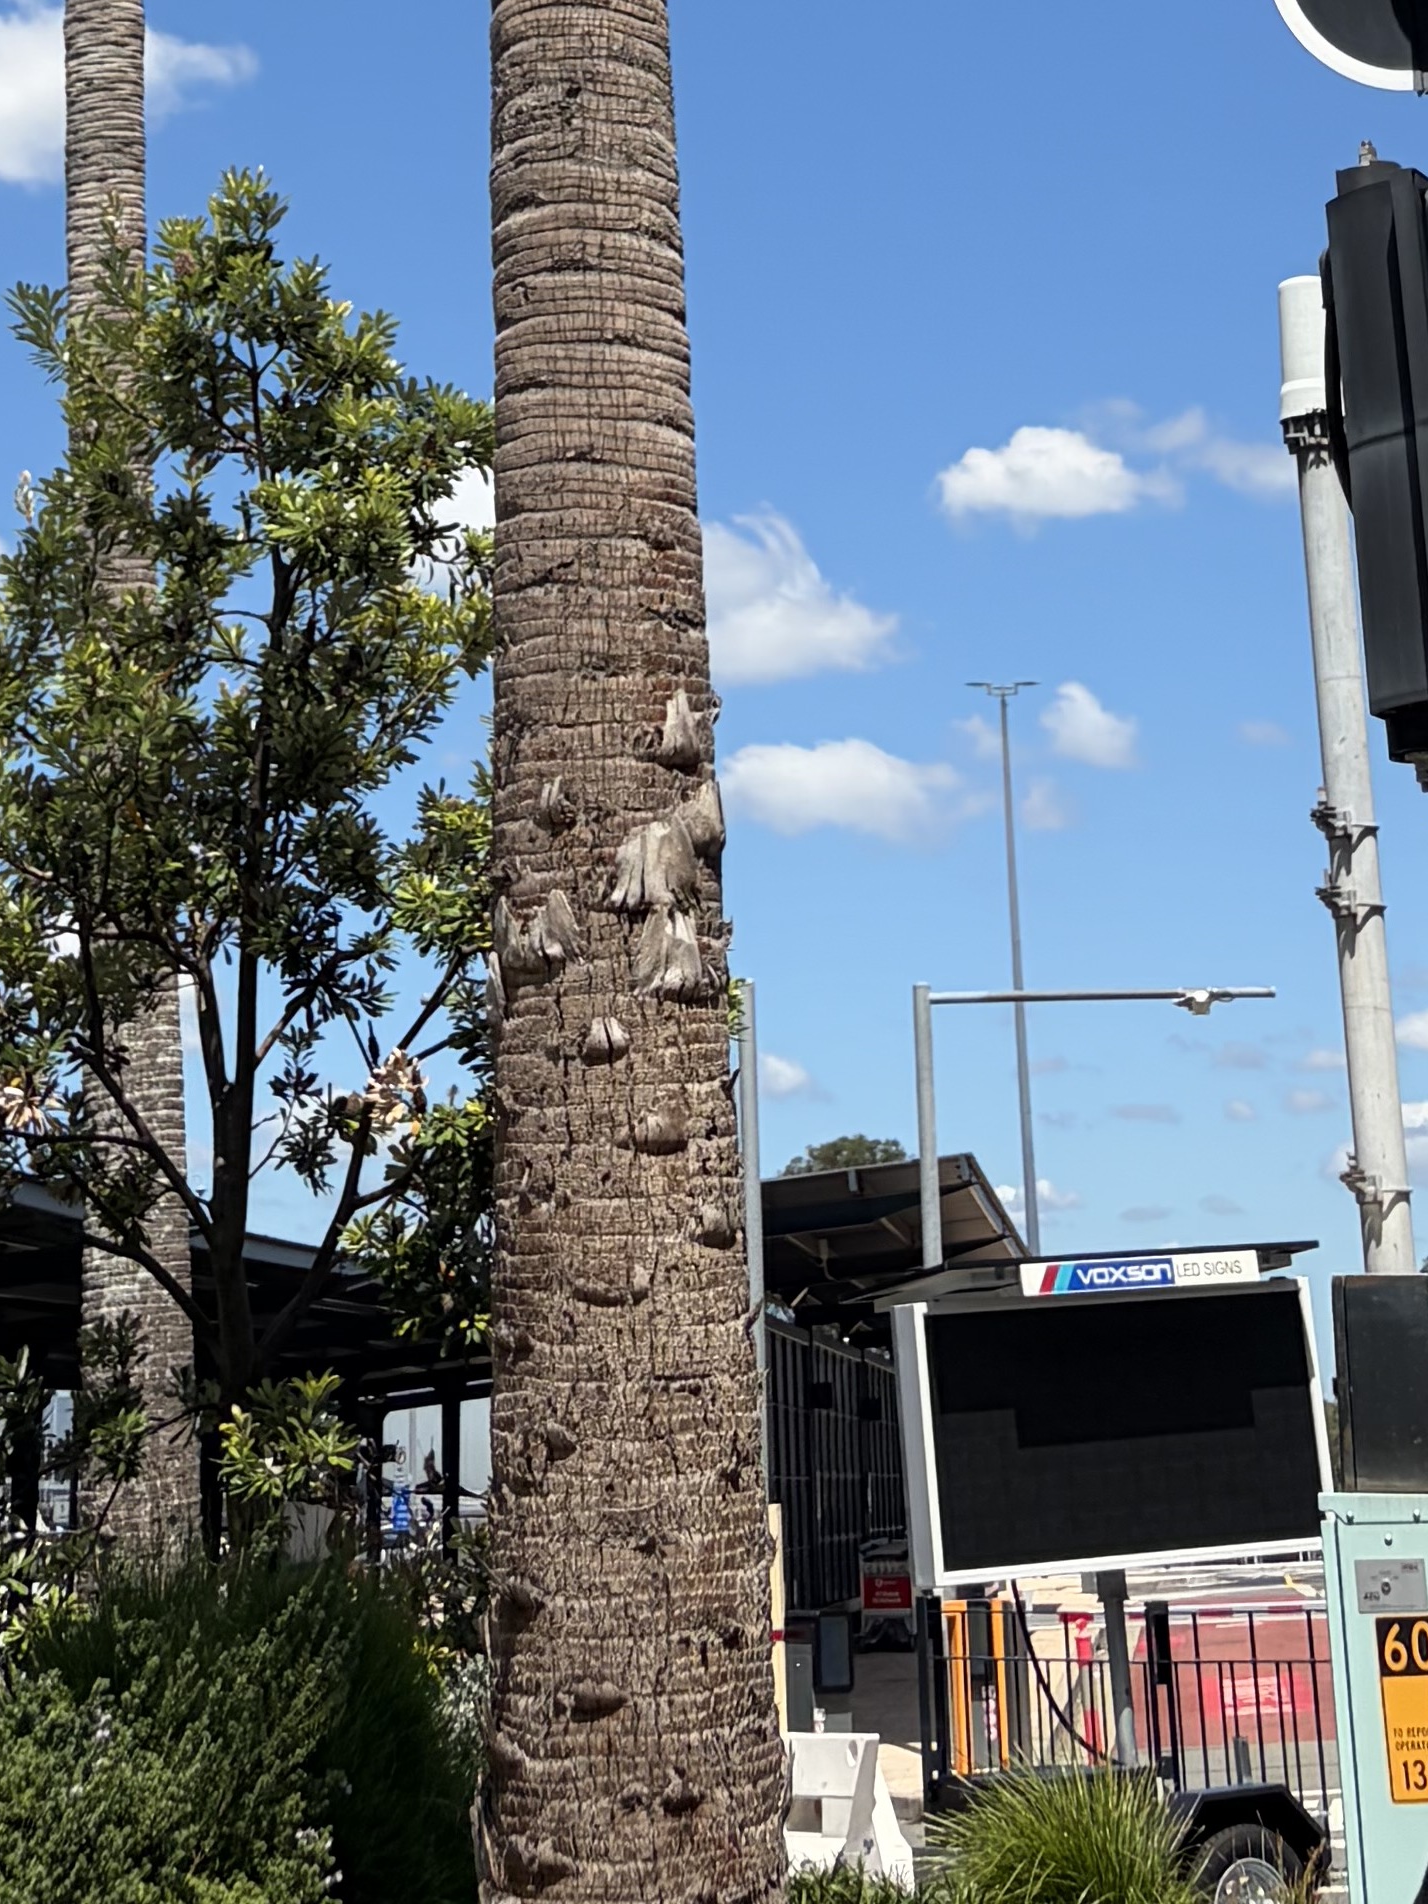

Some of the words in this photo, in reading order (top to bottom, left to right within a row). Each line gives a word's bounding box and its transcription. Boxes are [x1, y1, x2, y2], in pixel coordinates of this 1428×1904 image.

[1076, 1263, 1172, 1285] VOXSON
[1176, 1262, 1200, 1277] LED
[1204, 1260, 1242, 1276] SIGNS
[1393, 1727, 1404, 1737] TO
